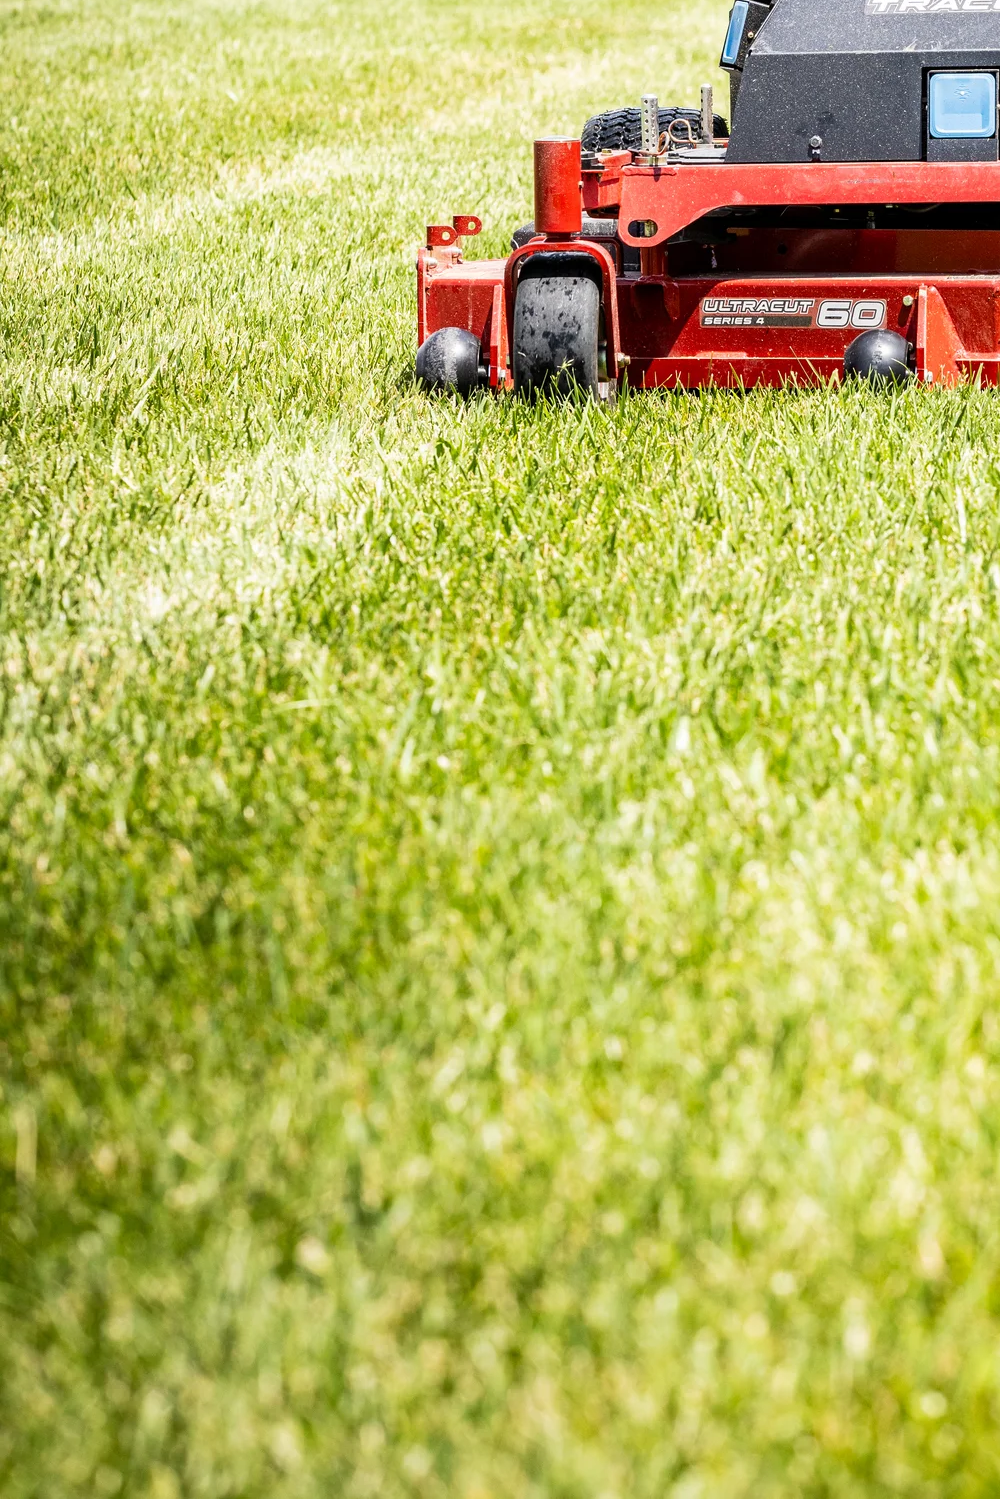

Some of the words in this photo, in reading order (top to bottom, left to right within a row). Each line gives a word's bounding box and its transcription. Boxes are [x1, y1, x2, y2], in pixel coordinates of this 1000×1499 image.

[703, 299, 814, 314] ULTRACUT
[816, 299, 886, 329] 60
[704, 316, 752, 326] SERIES
[755, 316, 765, 326] 4
